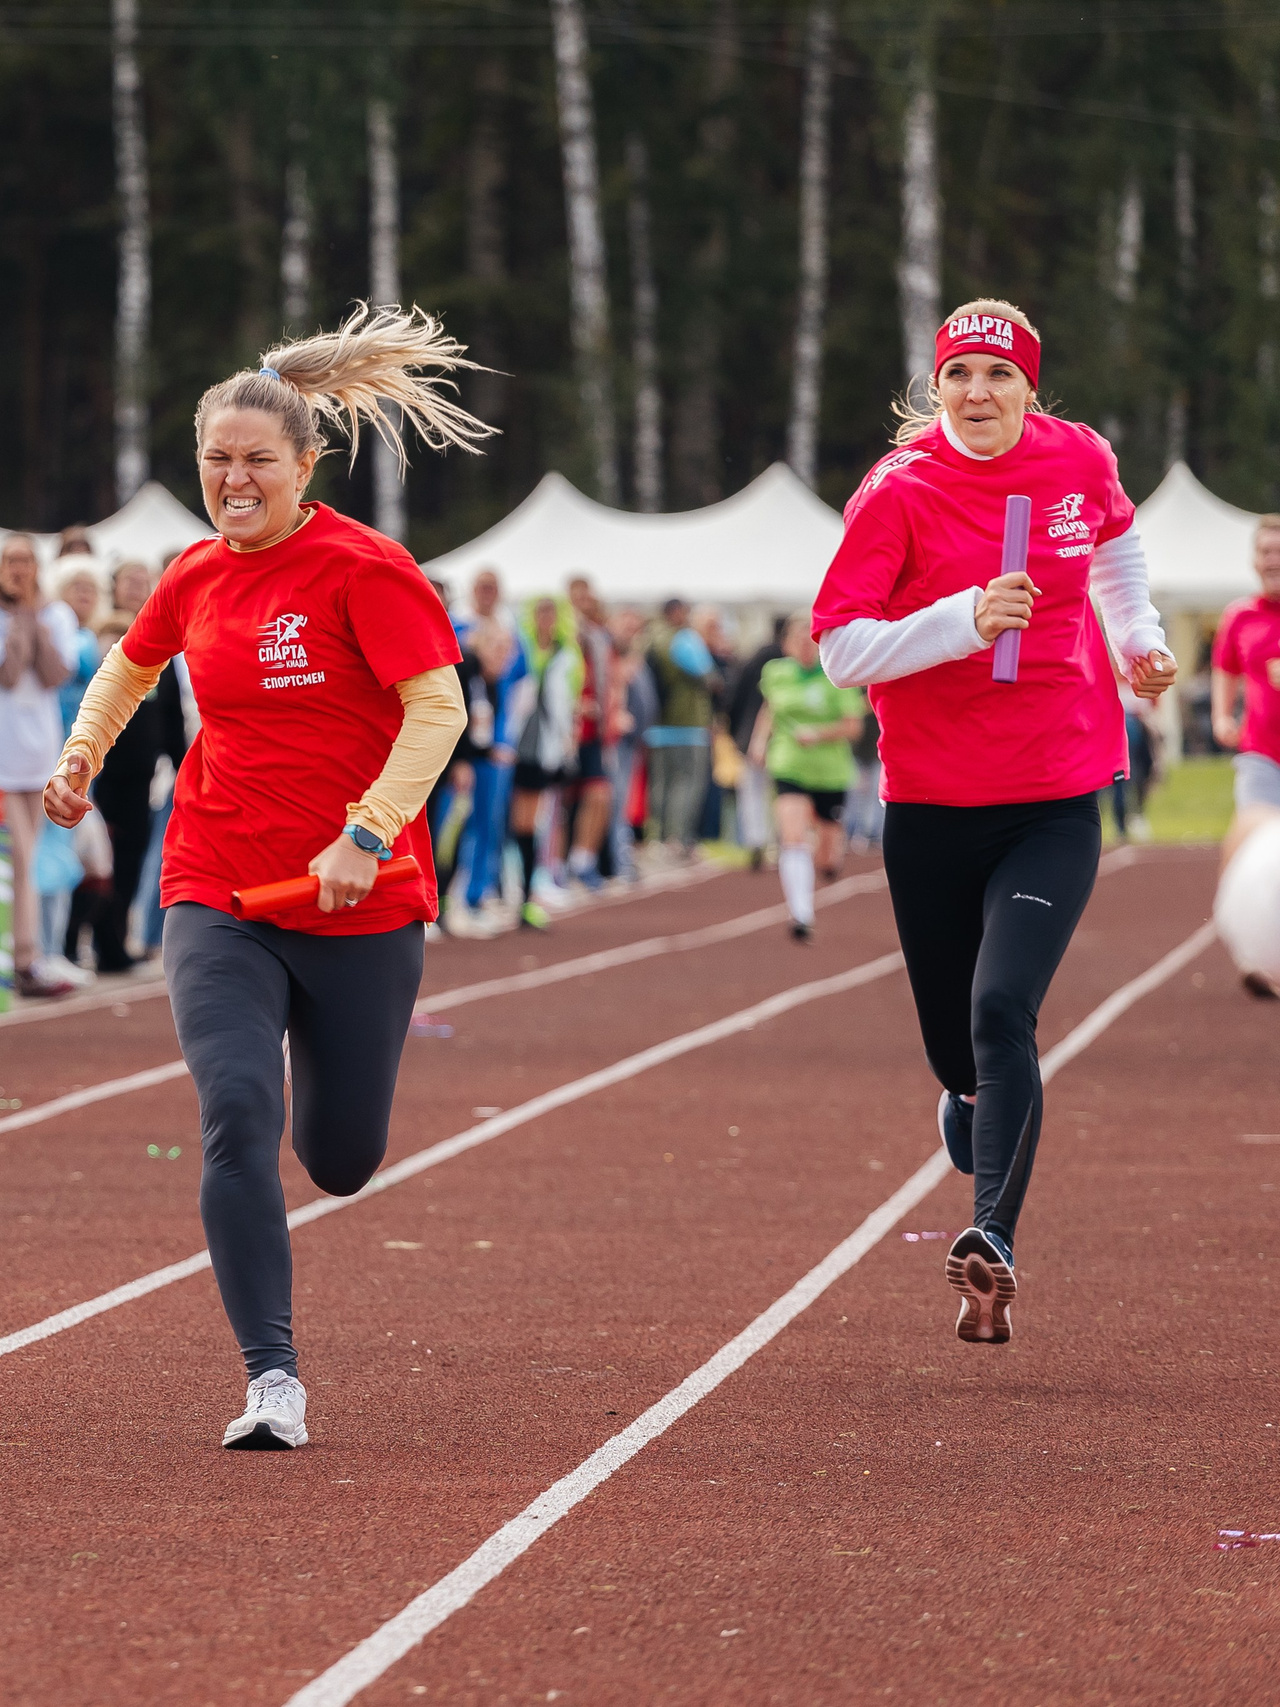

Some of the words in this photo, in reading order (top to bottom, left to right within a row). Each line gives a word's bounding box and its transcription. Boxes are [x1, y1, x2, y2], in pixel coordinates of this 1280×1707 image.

[948, 314, 1014, 340] СПАРТА
[984, 334, 1013, 350] КИАДА
[1047, 520, 1091, 538] СПАРТА
[258, 644, 308, 663] СПАРТА
[285, 658, 309, 669] КИАДА
[263, 670, 326, 690] СПОРТСМЕН
